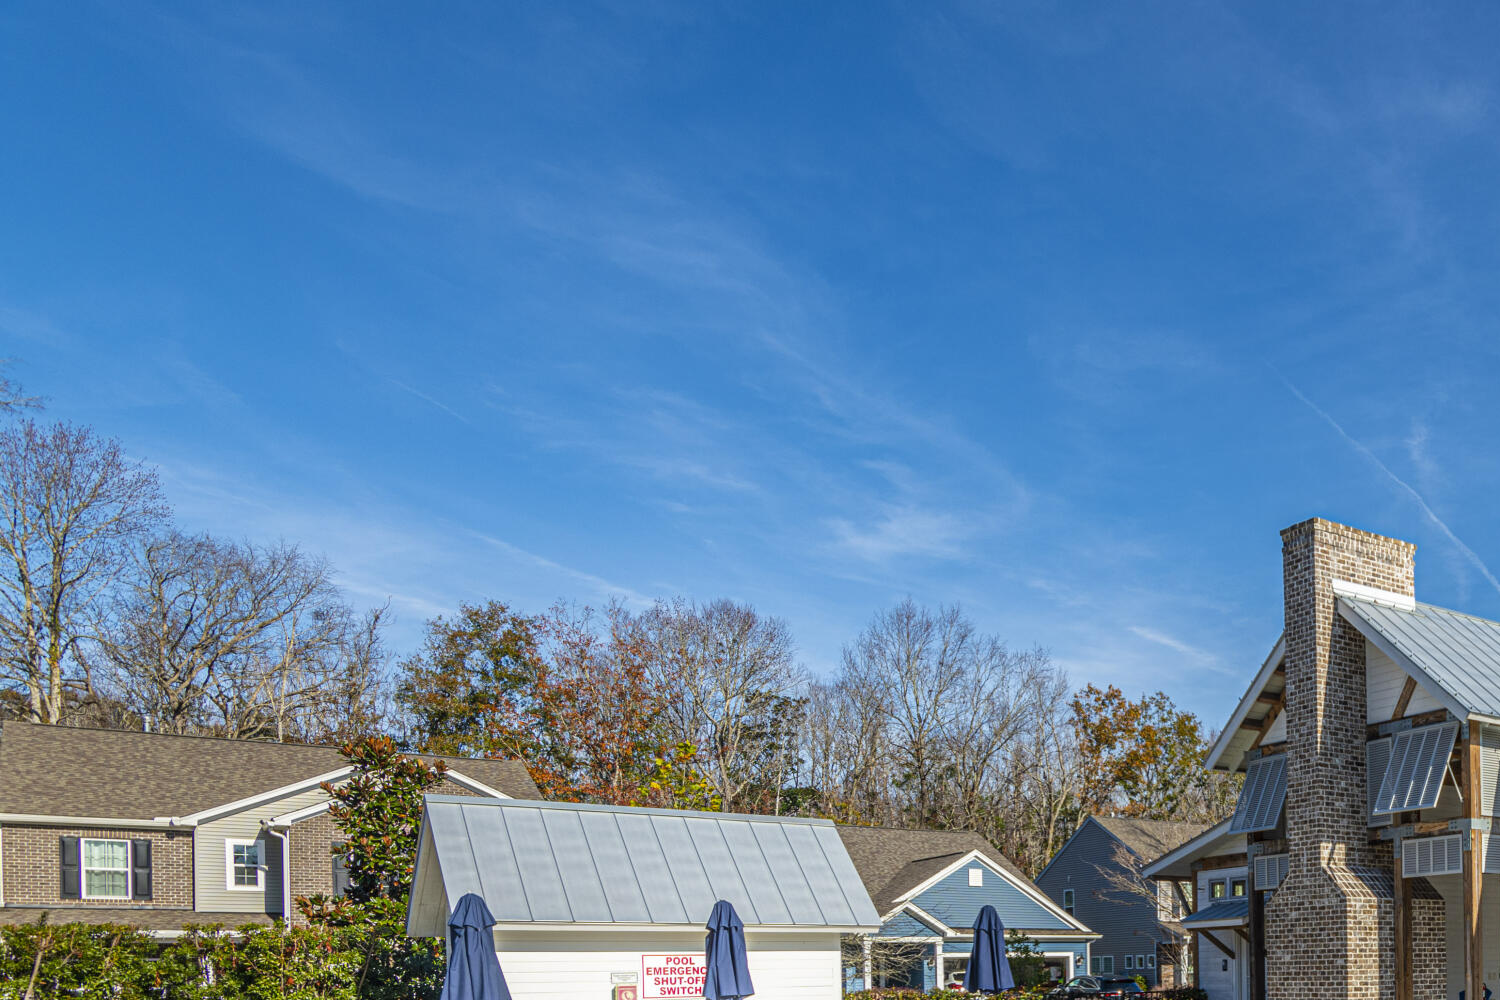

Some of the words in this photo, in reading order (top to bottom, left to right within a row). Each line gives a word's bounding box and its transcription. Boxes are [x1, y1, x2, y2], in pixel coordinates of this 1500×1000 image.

[666, 957, 695, 966] POOL
[646, 966, 708, 976] EMERGENC
[660, 986, 702, 995] SWITCH
